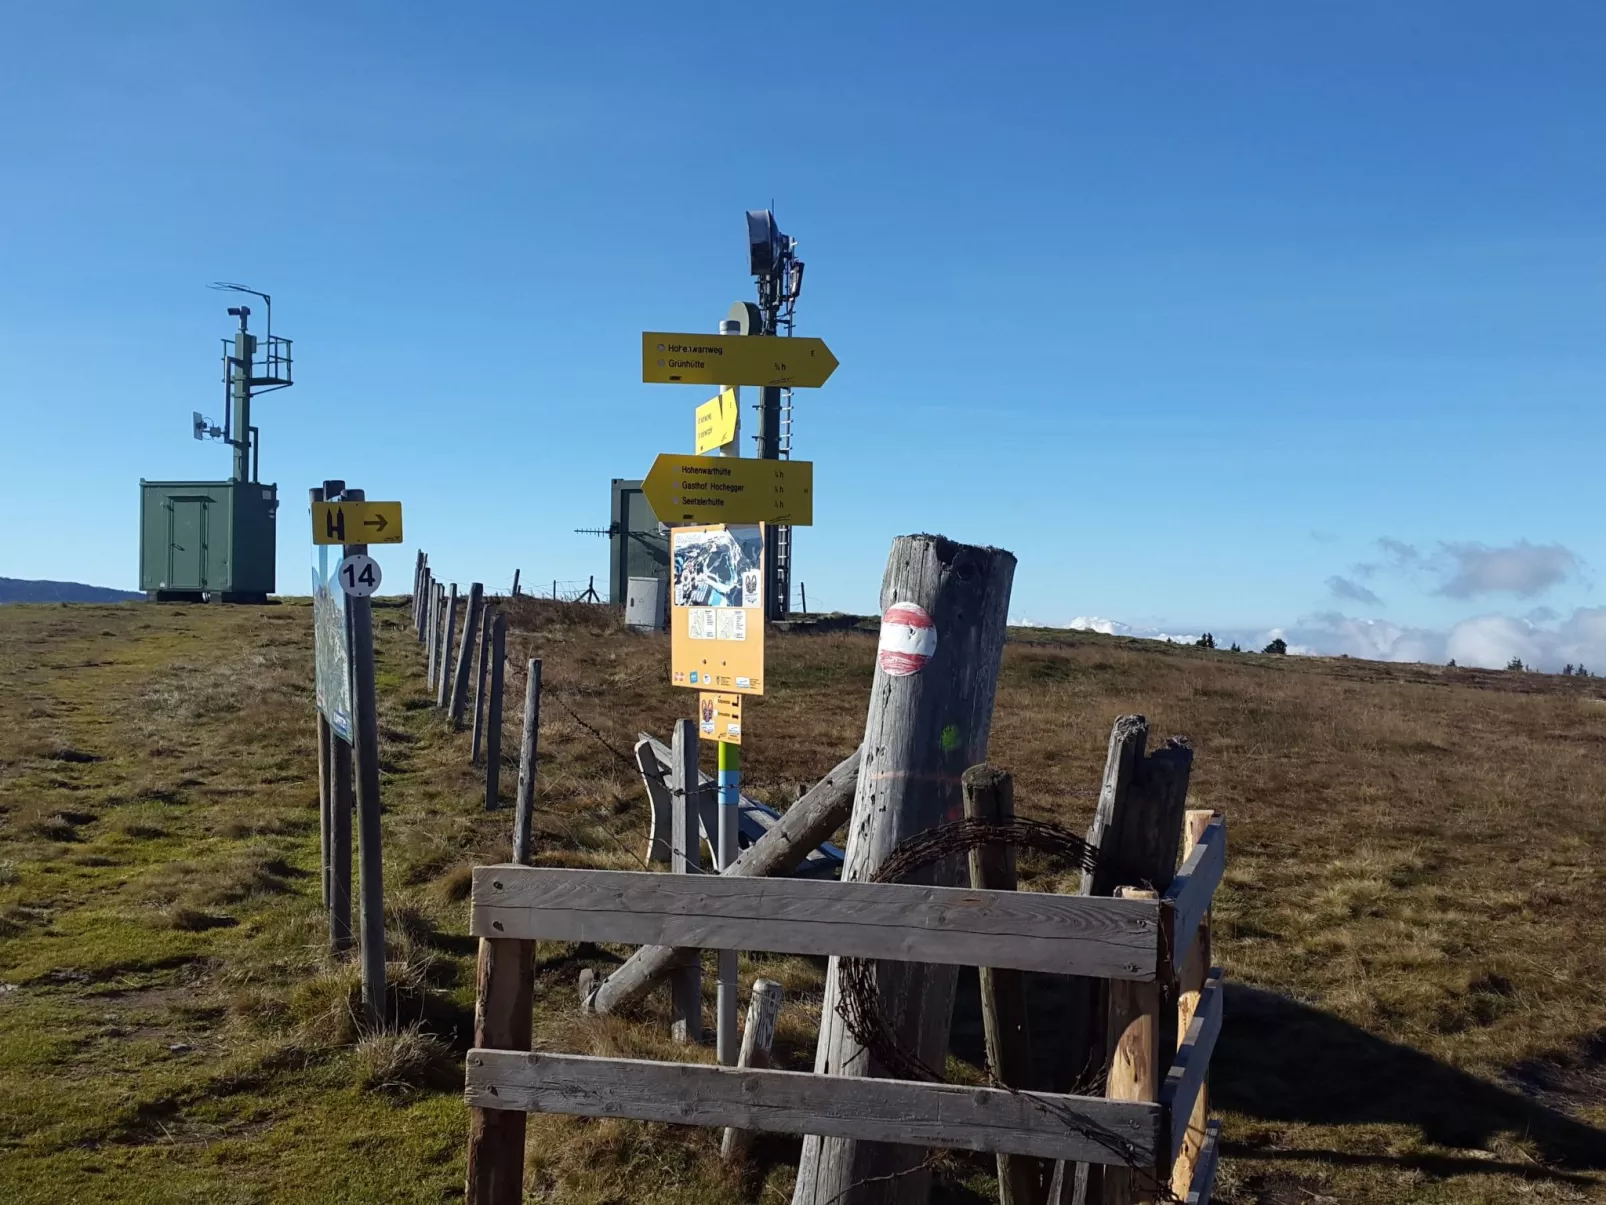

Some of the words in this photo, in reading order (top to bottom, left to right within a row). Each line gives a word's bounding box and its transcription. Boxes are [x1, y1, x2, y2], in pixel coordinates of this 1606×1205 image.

[682, 465, 732, 476] Hohenwarthütte
[682, 480, 708, 490] Gasthof
[710, 482, 744, 493] Hochegger
[682, 496, 724, 507] Seetalerhütte
[342, 563, 376, 588] 14
